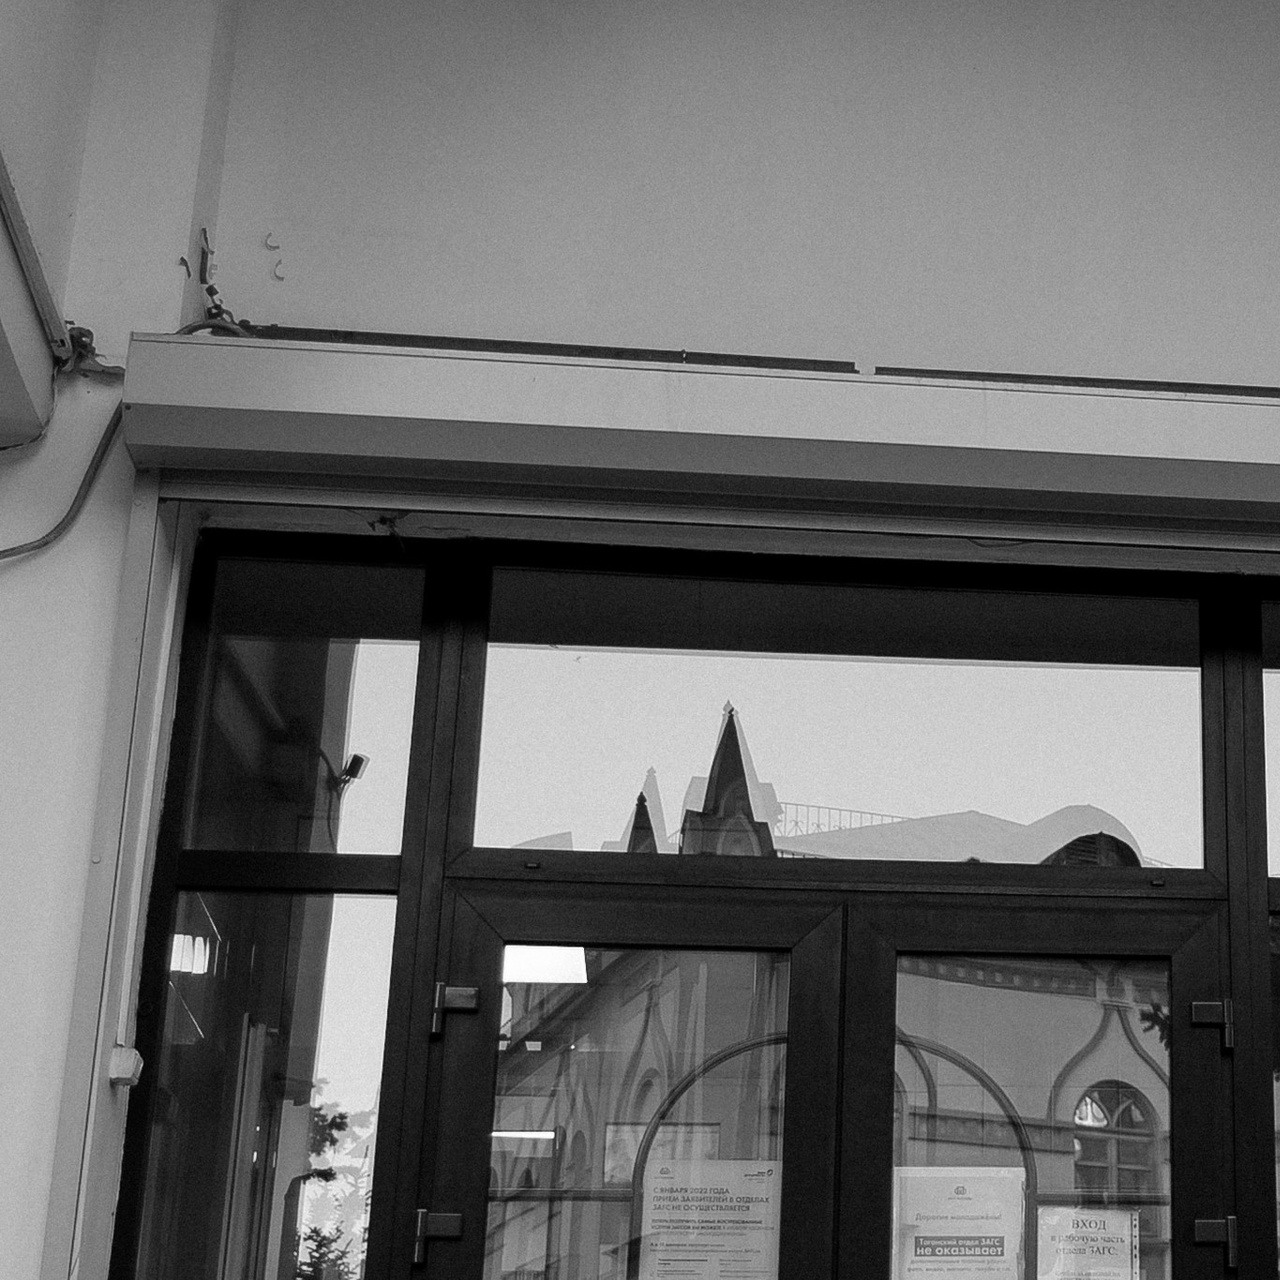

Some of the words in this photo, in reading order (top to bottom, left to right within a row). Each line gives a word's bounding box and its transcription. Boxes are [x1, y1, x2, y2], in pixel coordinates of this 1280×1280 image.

[1071, 1219, 1106, 1231] ВХОД
[1058, 1233, 1098, 1244] рабочую
[916, 1247, 932, 1255] не
[935, 1247, 1003, 1255] оказывает
